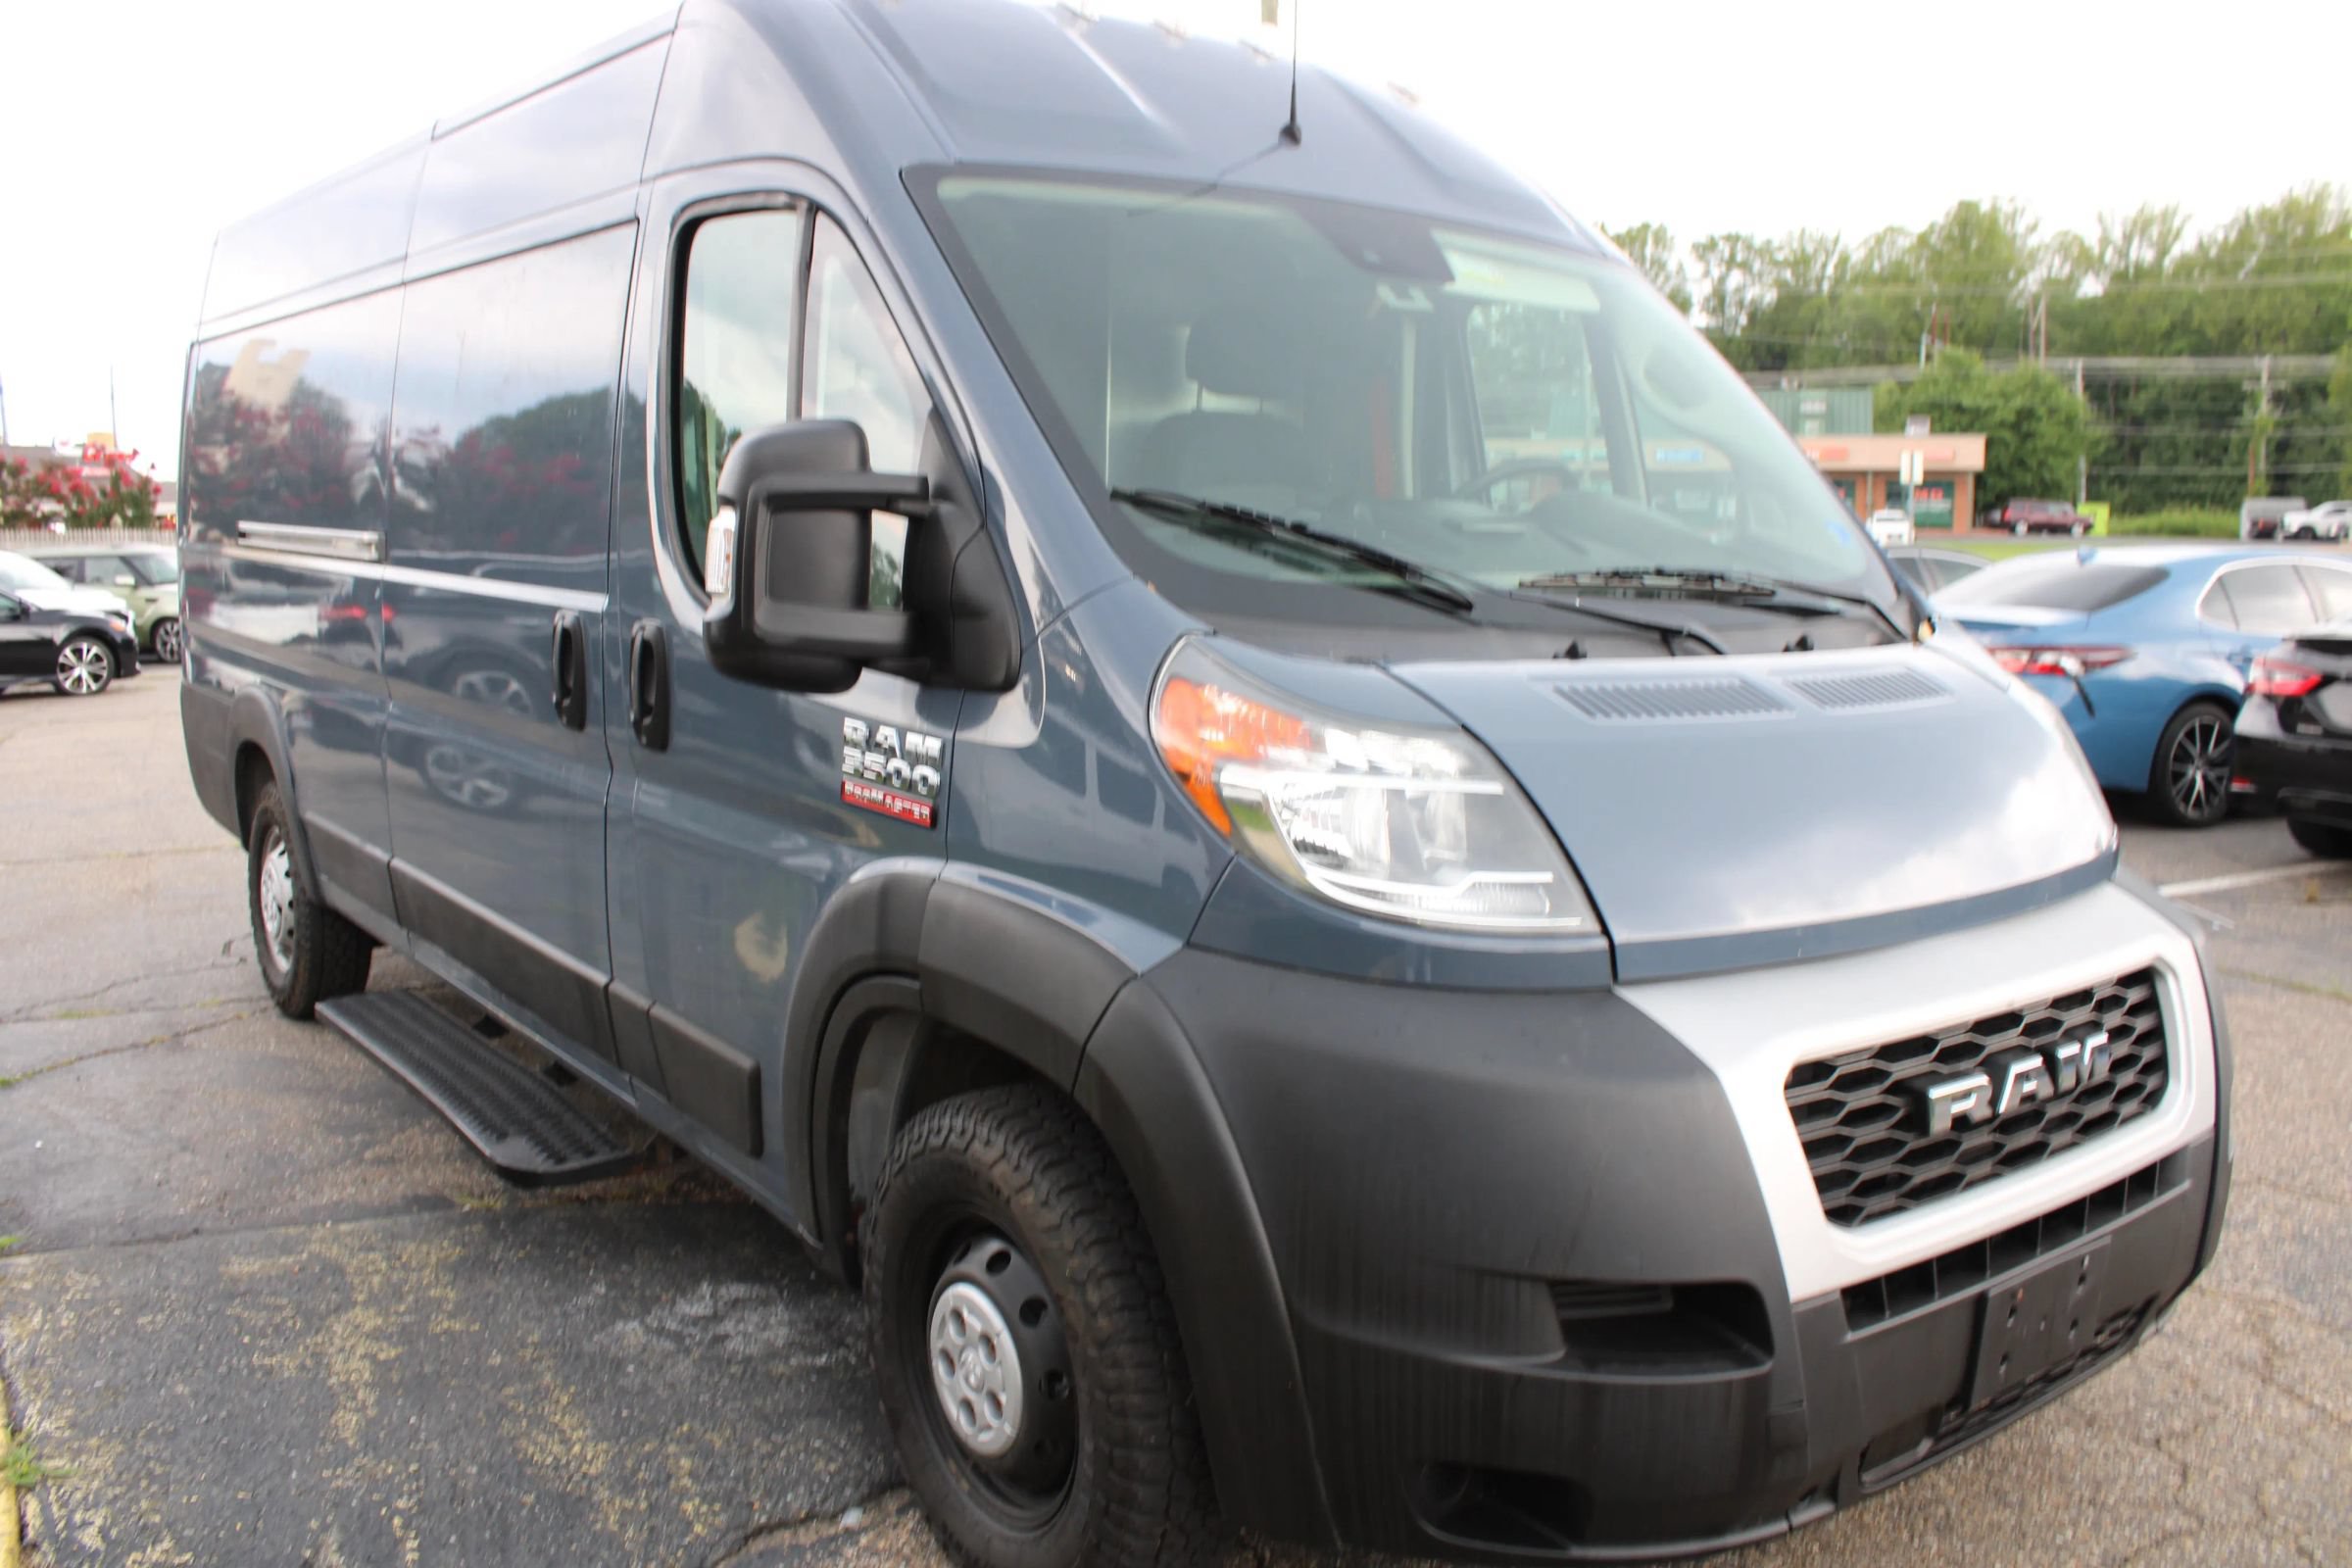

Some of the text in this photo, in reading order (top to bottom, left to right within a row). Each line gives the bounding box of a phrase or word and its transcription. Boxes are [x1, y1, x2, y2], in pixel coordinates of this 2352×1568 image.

[844, 716, 945, 768] RAM
[844, 781, 930, 821] PROMASTER
[1928, 1031, 2111, 1137] RAM
